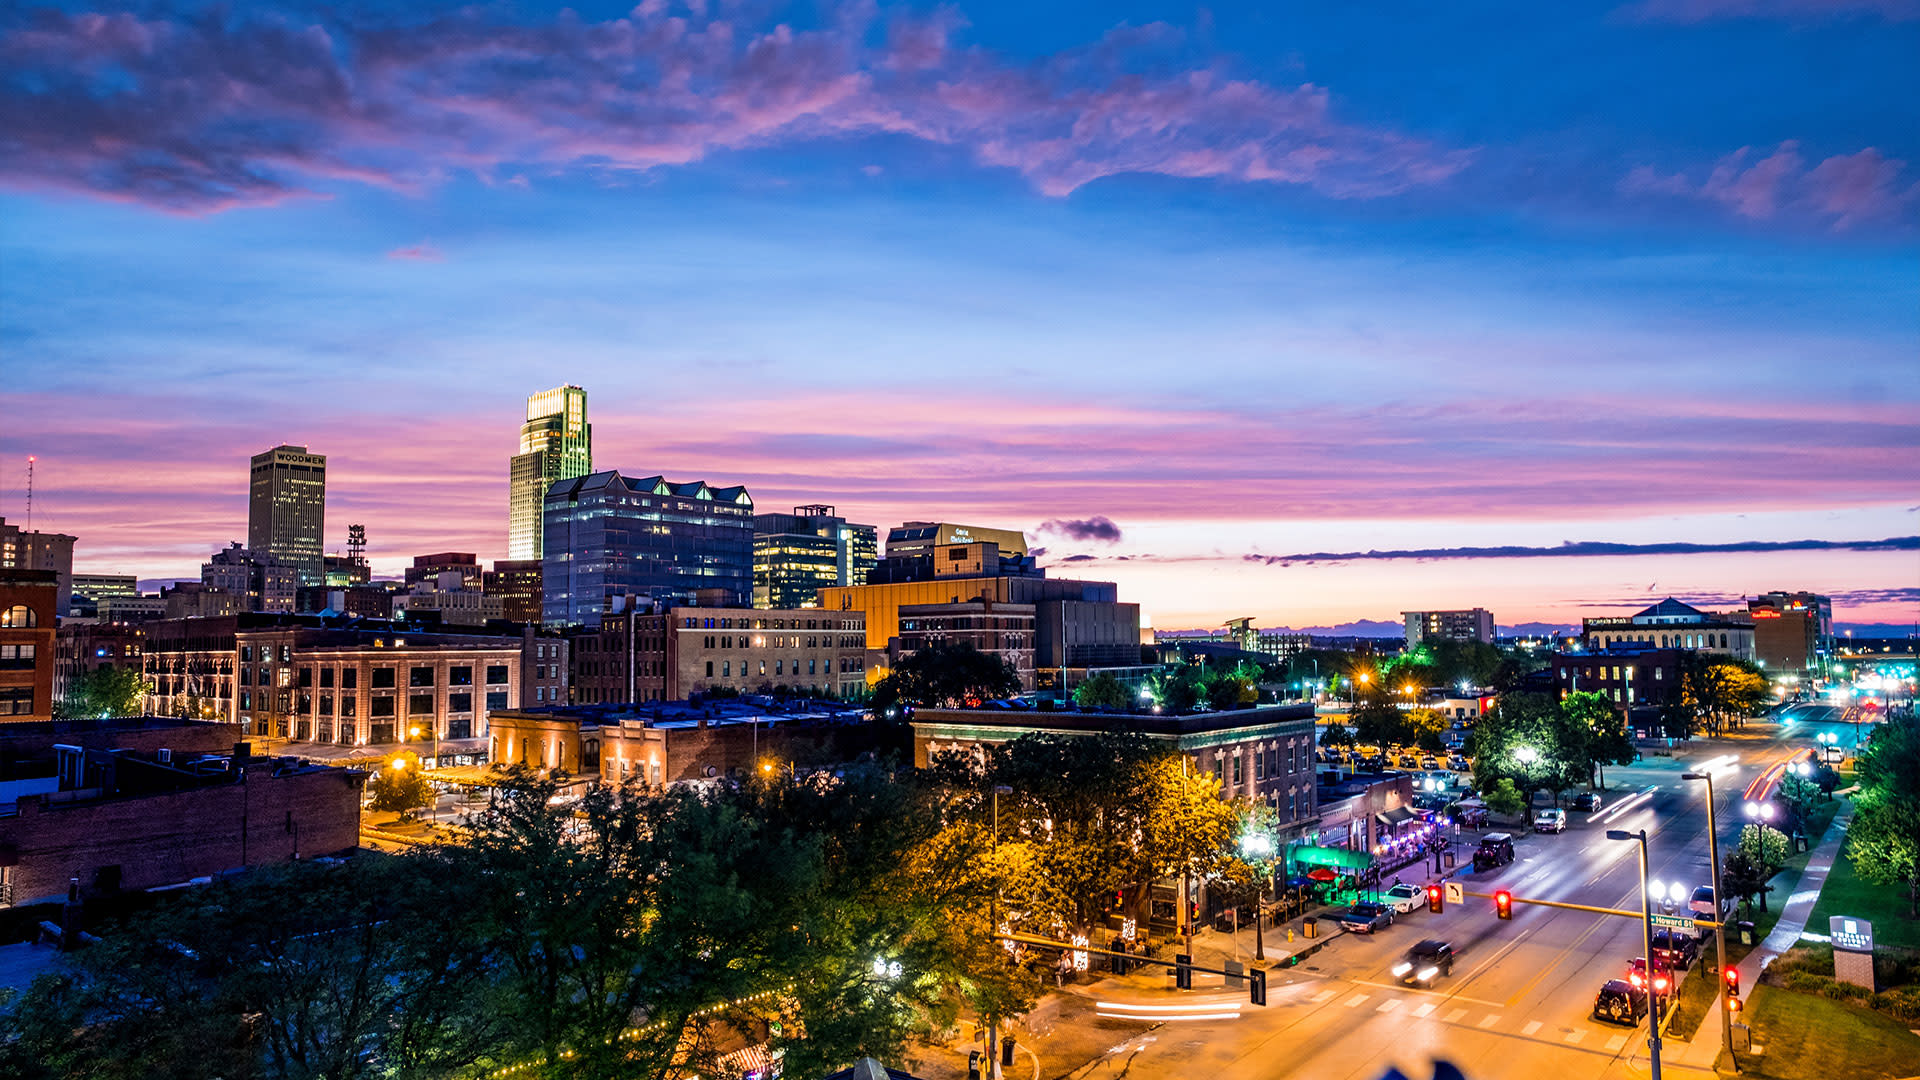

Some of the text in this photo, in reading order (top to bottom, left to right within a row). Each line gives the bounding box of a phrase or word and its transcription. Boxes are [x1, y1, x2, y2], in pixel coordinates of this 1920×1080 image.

[277, 454, 324, 464] WOODMEN
[1656, 916, 1692, 928] Howard St
